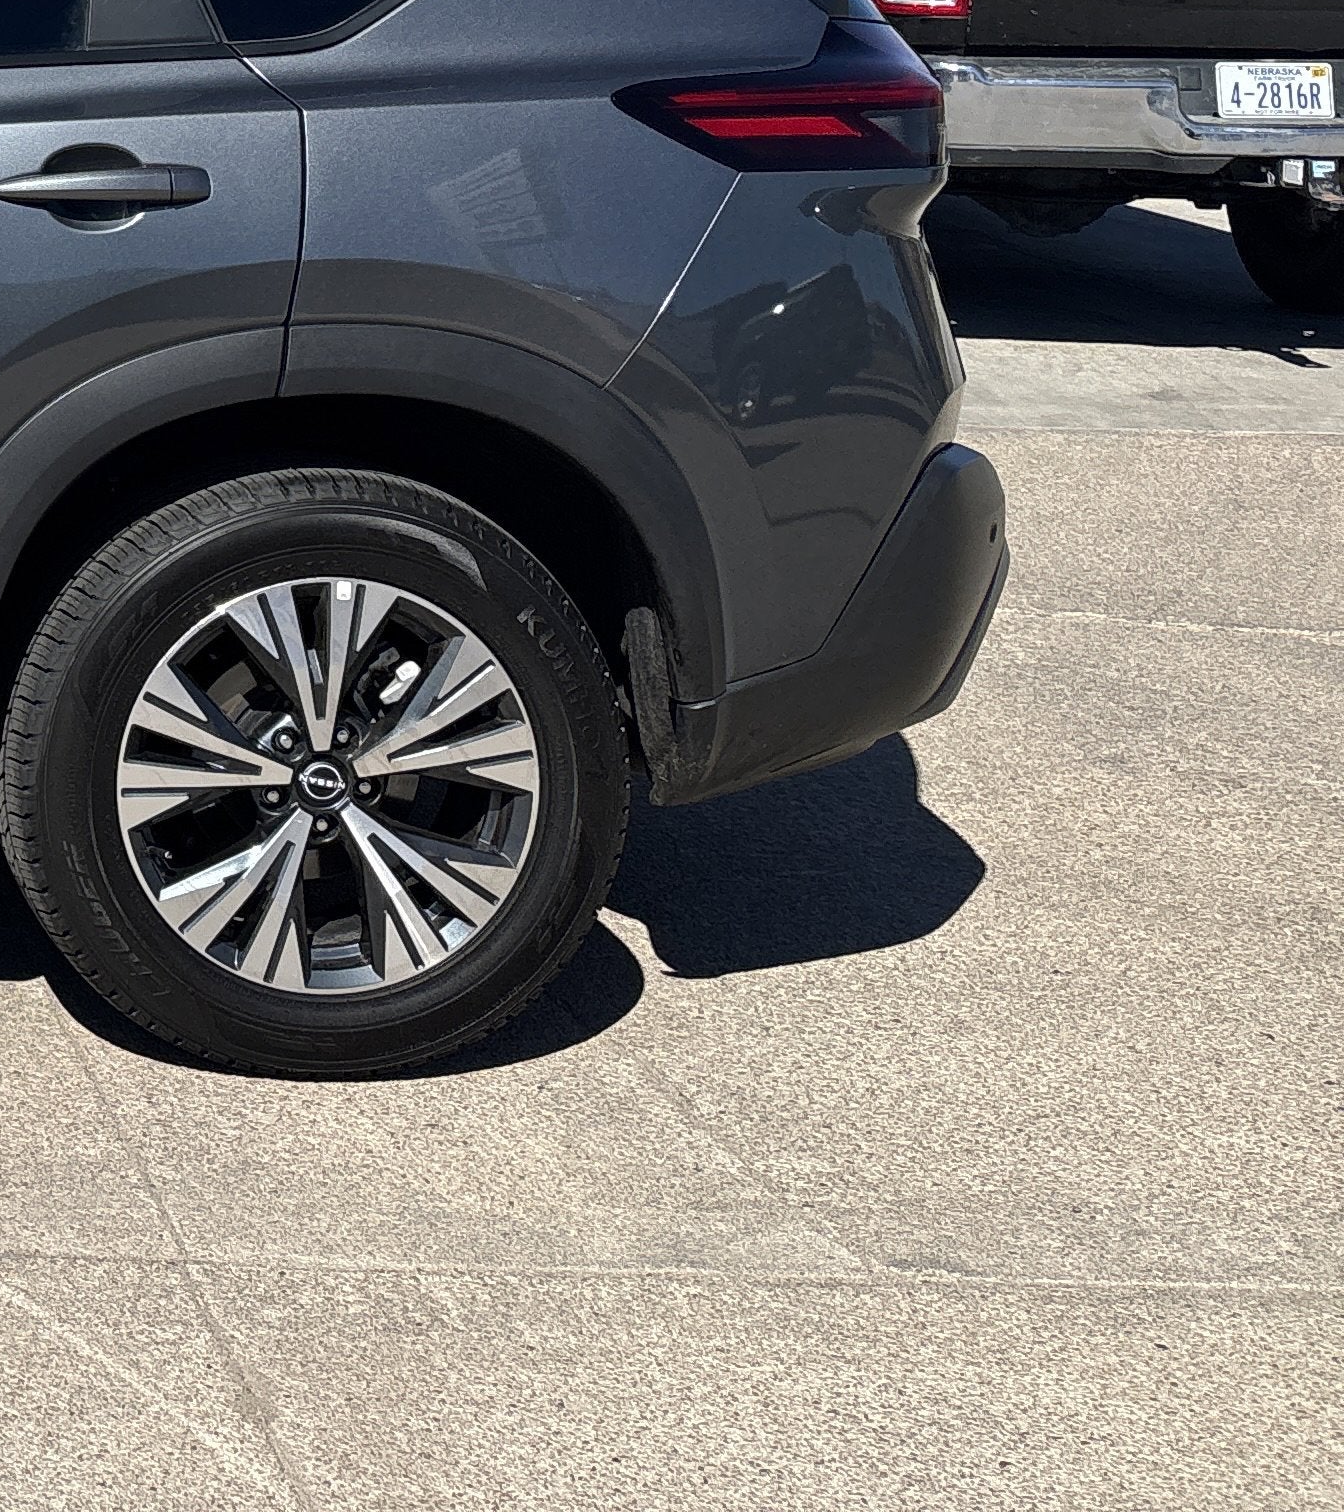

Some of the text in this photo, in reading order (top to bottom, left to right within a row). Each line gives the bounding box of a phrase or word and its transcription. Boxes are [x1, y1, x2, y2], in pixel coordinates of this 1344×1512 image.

[1247, 67, 1303, 76] NEBRASKA
[1230, 81, 1322, 109] 4-2816R
[299, 773, 347, 791] NISSAN
